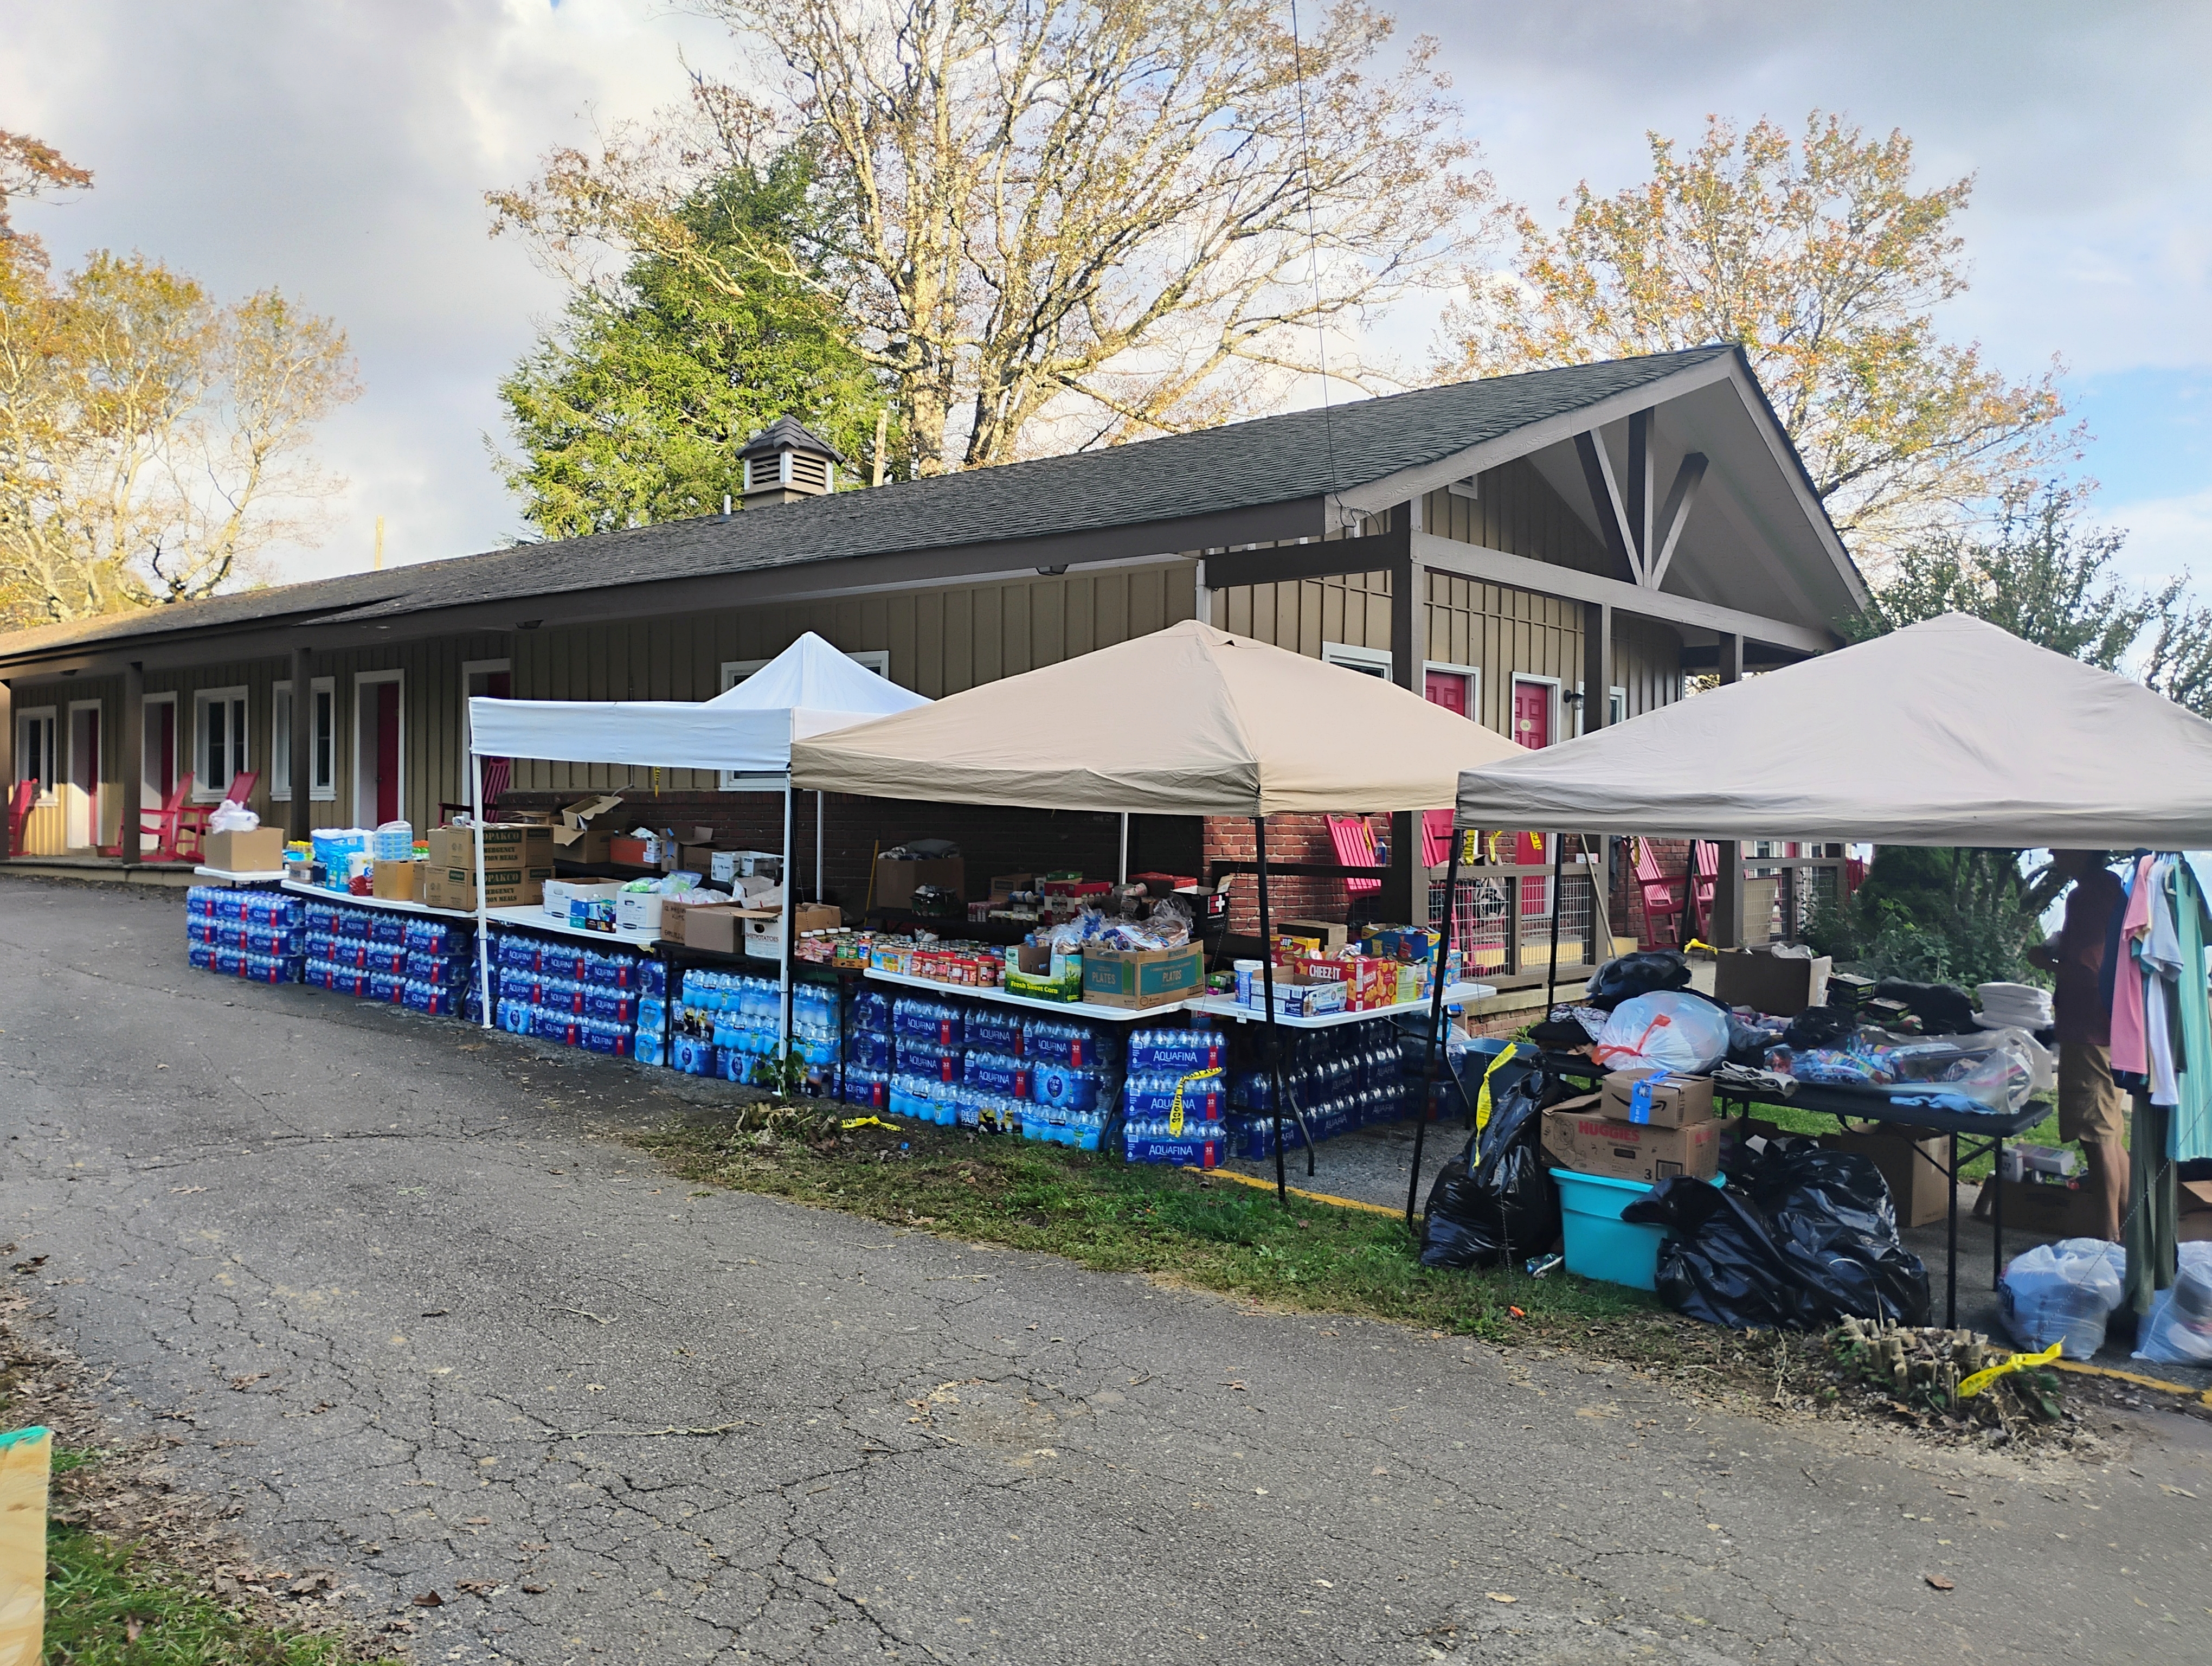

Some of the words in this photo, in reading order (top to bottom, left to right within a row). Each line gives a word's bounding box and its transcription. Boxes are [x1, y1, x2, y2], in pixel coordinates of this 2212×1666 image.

[484, 831, 519, 841] OPAKCO
[485, 873, 518, 882] OPAKCO
[1092, 972, 1116, 985] PLATES
[1011, 981, 1026, 989] Fresh
[1027, 983, 1043, 991] Sweet
[1044, 986, 1058, 994] Corn
[1153, 1050, 1198, 1063] AQUAFINA
[1150, 1098, 1196, 1110] AQUANA
[1578, 1120, 1640, 1142] HUGGIES
[1148, 1144, 1193, 1156] AQUAFINA
[1644, 1168, 1652, 1180] 3
